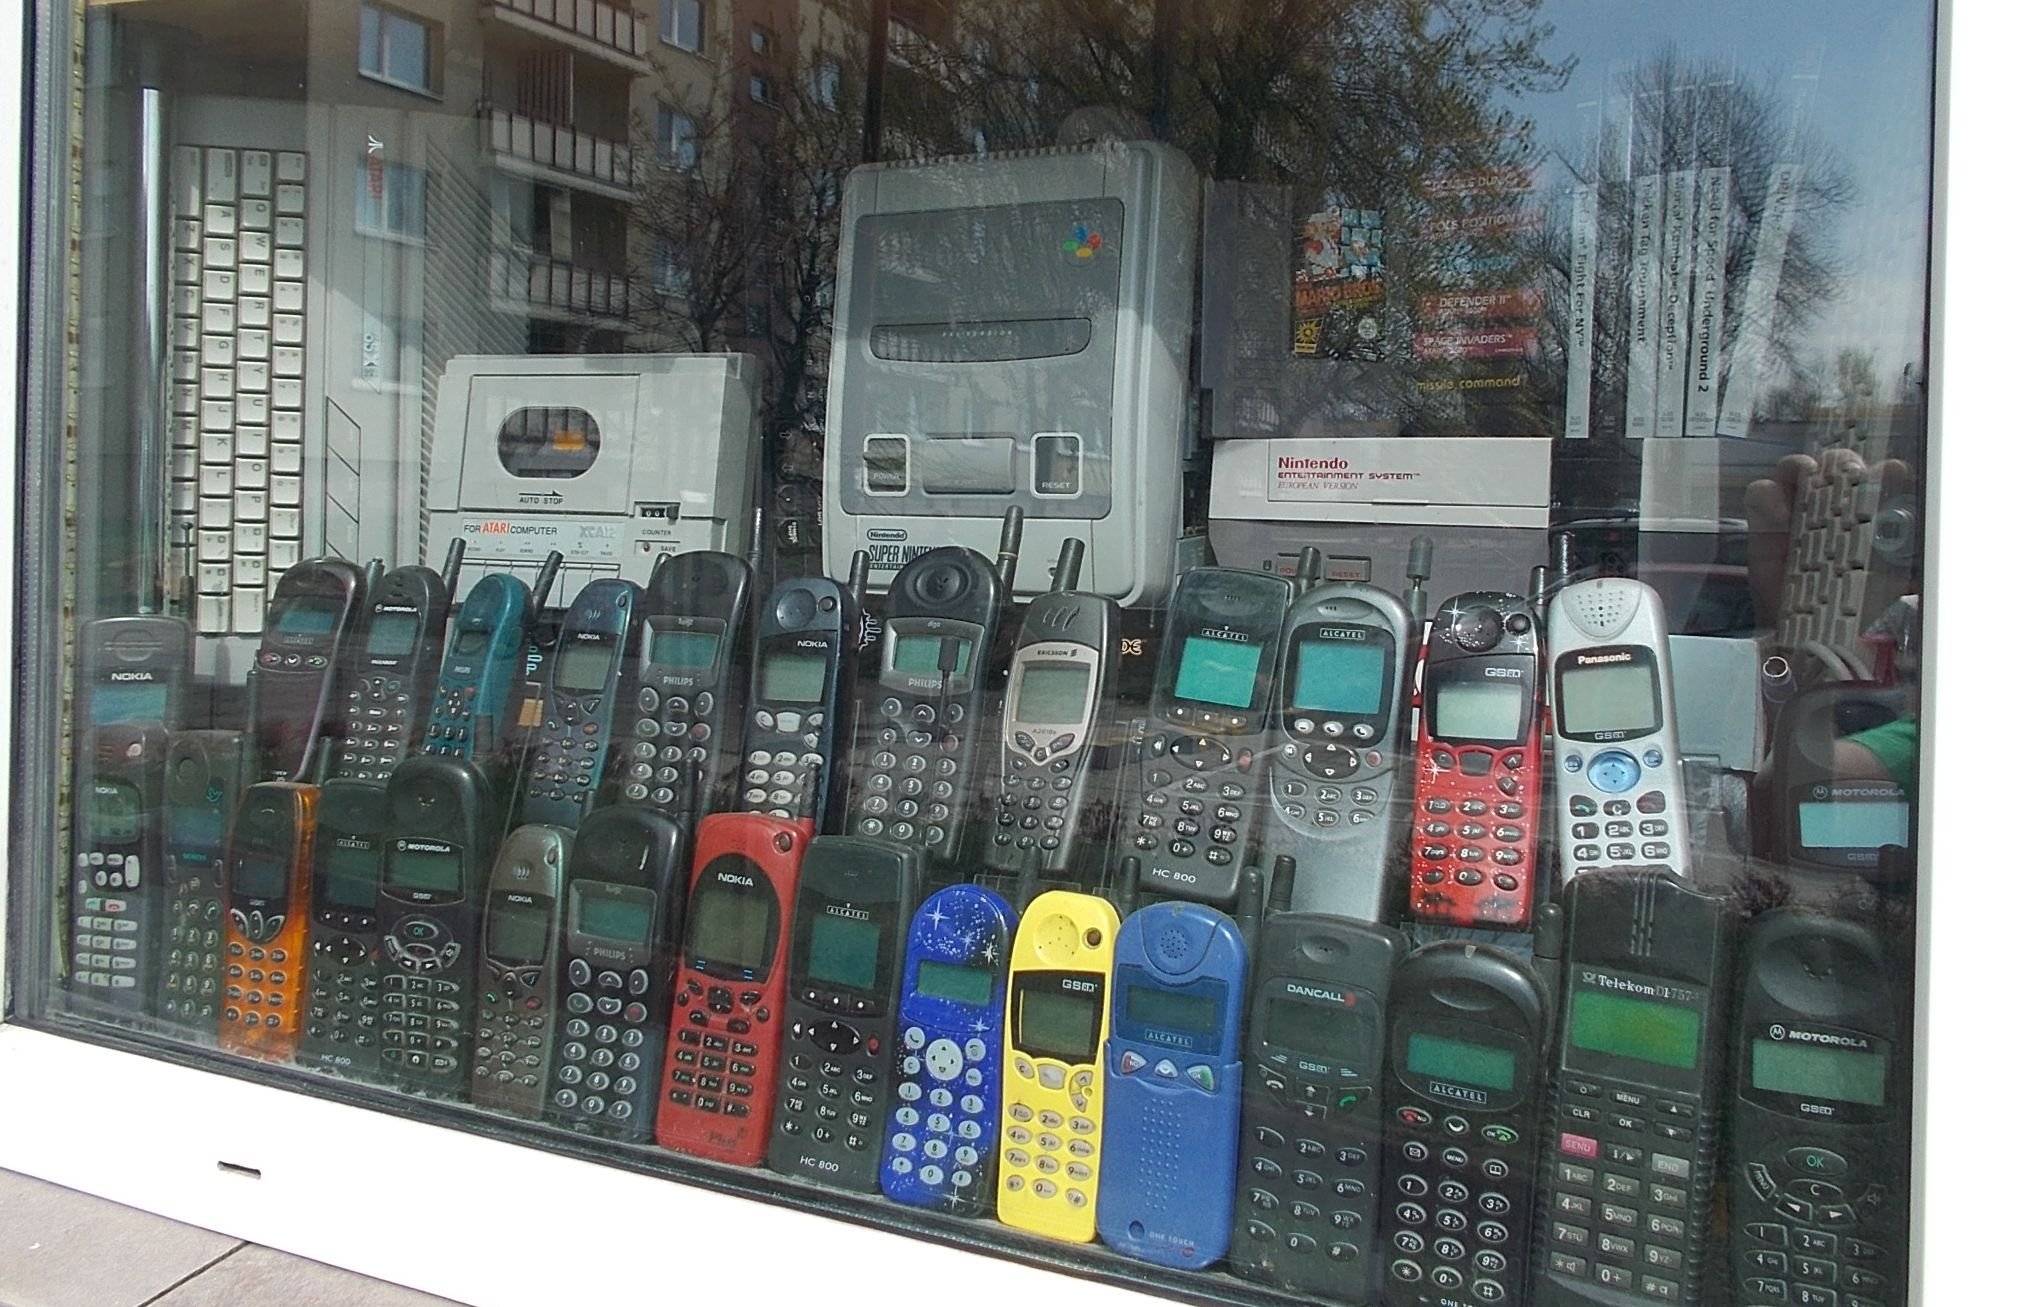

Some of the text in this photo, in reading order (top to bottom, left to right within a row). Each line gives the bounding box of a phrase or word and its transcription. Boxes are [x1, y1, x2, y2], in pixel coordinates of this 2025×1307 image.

[1708, 214, 1720, 237] for
[1637, 232, 1650, 257] Tag
[1575, 253, 1587, 289] Fight
[1440, 295, 1495, 307] DEFENDER
[1576, 293, 1586, 316] For
[1423, 336, 1454, 347] SPACE
[1698, 290, 1715, 380] Underground
[1460, 375, 1521, 388] command
[1697, 384, 1709, 393] 2
[1278, 456, 1349, 469] Nintendo
[1277, 471, 1364, 480] ENTERTAINMENT
[1042, 481, 1071, 490] RESET
[1277, 481, 1359, 490] EUROPEAN VERSION
[519, 496, 564, 505] AUTO STOP
[463, 522, 557, 536] FOR ATARI COMPUTER
[641, 529, 672, 537] COUNTER
[869, 530, 905, 540] Nintendo
[660, 545, 677, 553] SAVE
[868, 545, 900, 563] SUPER
[577, 632, 600, 641] NOKIA
[1203, 628, 1247, 642] ALCATEL
[1322, 628, 1364, 640] ALCATEL
[797, 640, 828, 649] NOKIA
[1036, 648, 1068, 657] ERICSSON
[1578, 652, 1631, 665] Panasonic
[111, 672, 153, 681] NOKIA
[663, 675, 694, 686] PHILIPS
[908, 677, 943, 689] PHILIPS
[1152, 772, 1158, 783] 1
[95, 786, 118, 795] NOKIA
[1831, 787, 1905, 797] MOTOROLA
[1611, 804, 1623, 816] C
[1576, 825, 1585, 837] 1
[407, 842, 451, 854] MOTOROLA
[717, 872, 754, 887] NOKIA
[1152, 867, 1197, 884] HC 800
[507, 894, 533, 904] NOKIA
[827, 905, 868, 920] ALCATEL
[412, 926, 425, 936] OK
[593, 947, 626, 961] PHILIPS
[1062, 978, 1095, 993] GSM
[1597, 974, 1655, 996] Telekom
[1286, 983, 1345, 1003] DANCALL
[1148, 1031, 1189, 1046] ALCATEL
[1789, 1029, 1868, 1048] MOTOROLA
[321, 1053, 352, 1066] HC 800
[793, 1055, 799, 1066] 1
[1432, 1083, 1484, 1102] ALCATEL
[1616, 1092, 1641, 1105] MENU
[1572, 1107, 1591, 1120] CLR
[1618, 1117, 1633, 1129] OK
[1565, 1139, 1592, 1153] SEND
[800, 1154, 839, 1173] HC 800
[1446, 1153, 1464, 1163] MENU
[1806, 1154, 1825, 1169] OK
[1656, 1159, 1680, 1173] END
[1810, 1183, 1820, 1196] C
